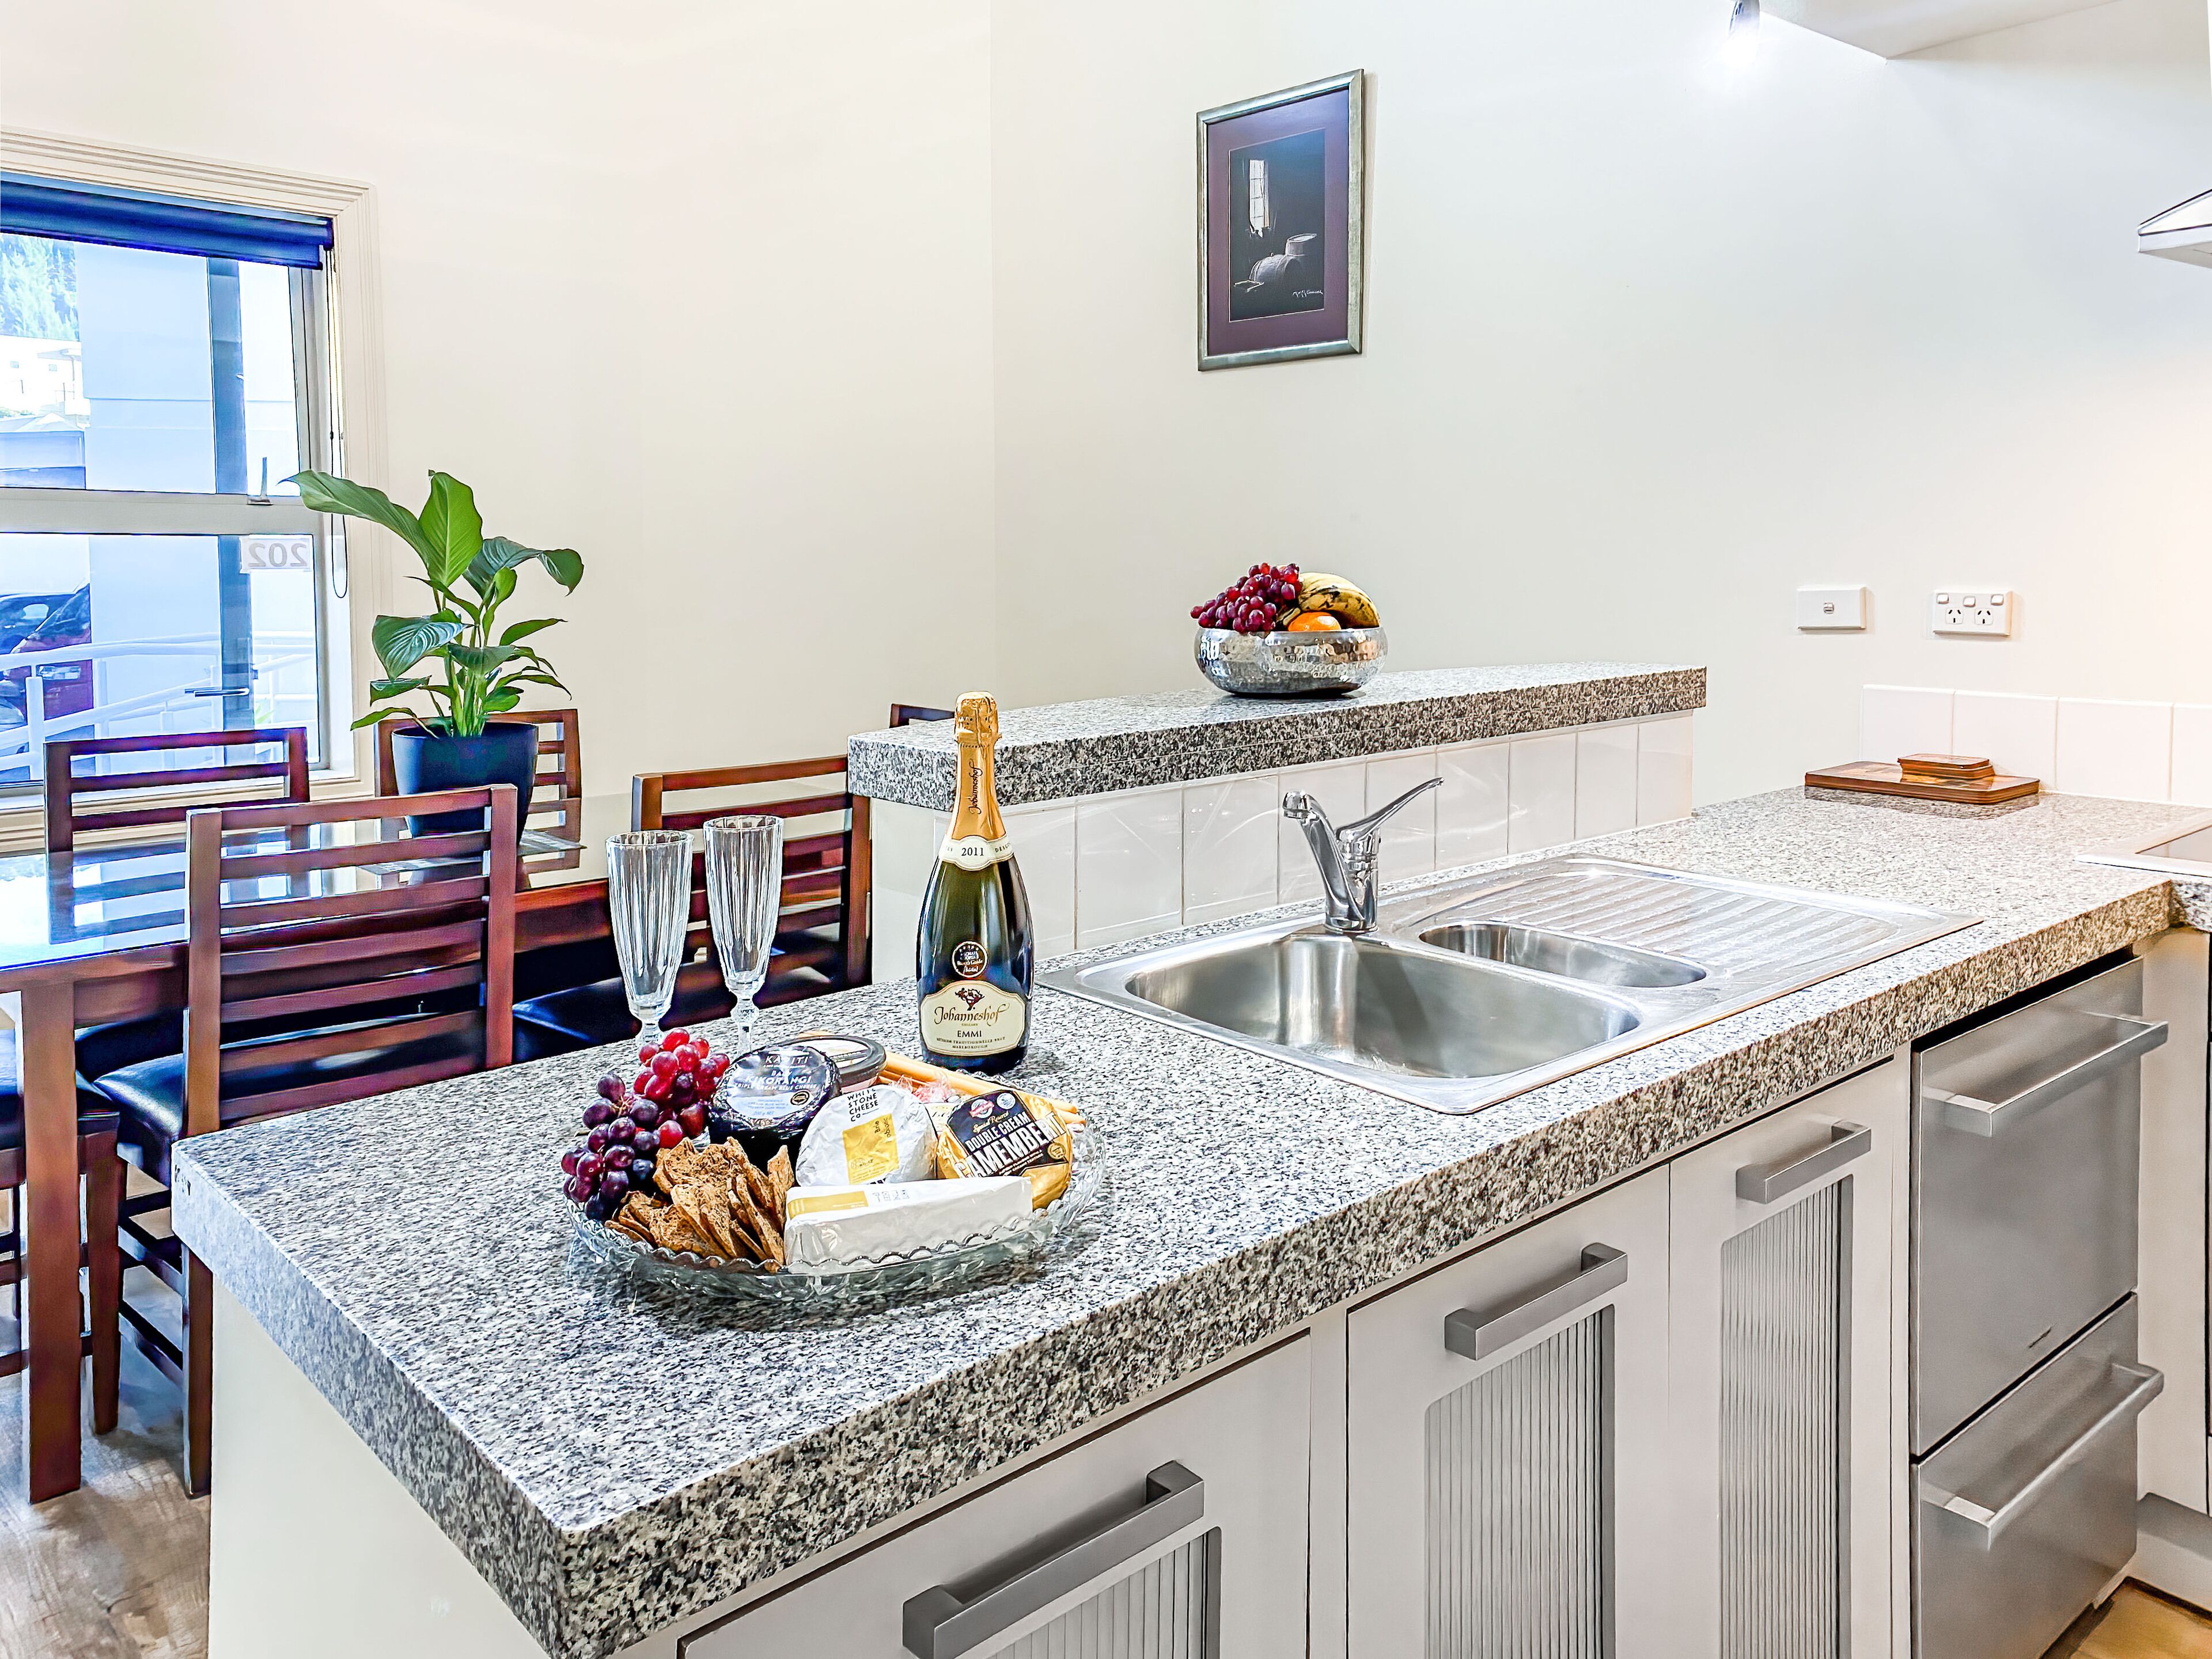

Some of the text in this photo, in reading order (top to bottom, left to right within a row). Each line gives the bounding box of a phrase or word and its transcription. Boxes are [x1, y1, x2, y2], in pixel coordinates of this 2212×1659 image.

[968, 758, 983, 814] Johanneshof
[961, 847, 984, 857] 2011
[934, 1002, 1010, 1027] Johanneshof
[765, 1055, 809, 1065] KAITI
[745, 1075, 812, 1085] KIKORANGI
[849, 1092, 877, 1108] STONE
[849, 1100, 878, 1115] CHEESE
[851, 1113, 861, 1122] CO
[964, 1111, 1031, 1152] DOUBLE CREAM
[954, 1111, 1066, 1177] CAMEMBERT
